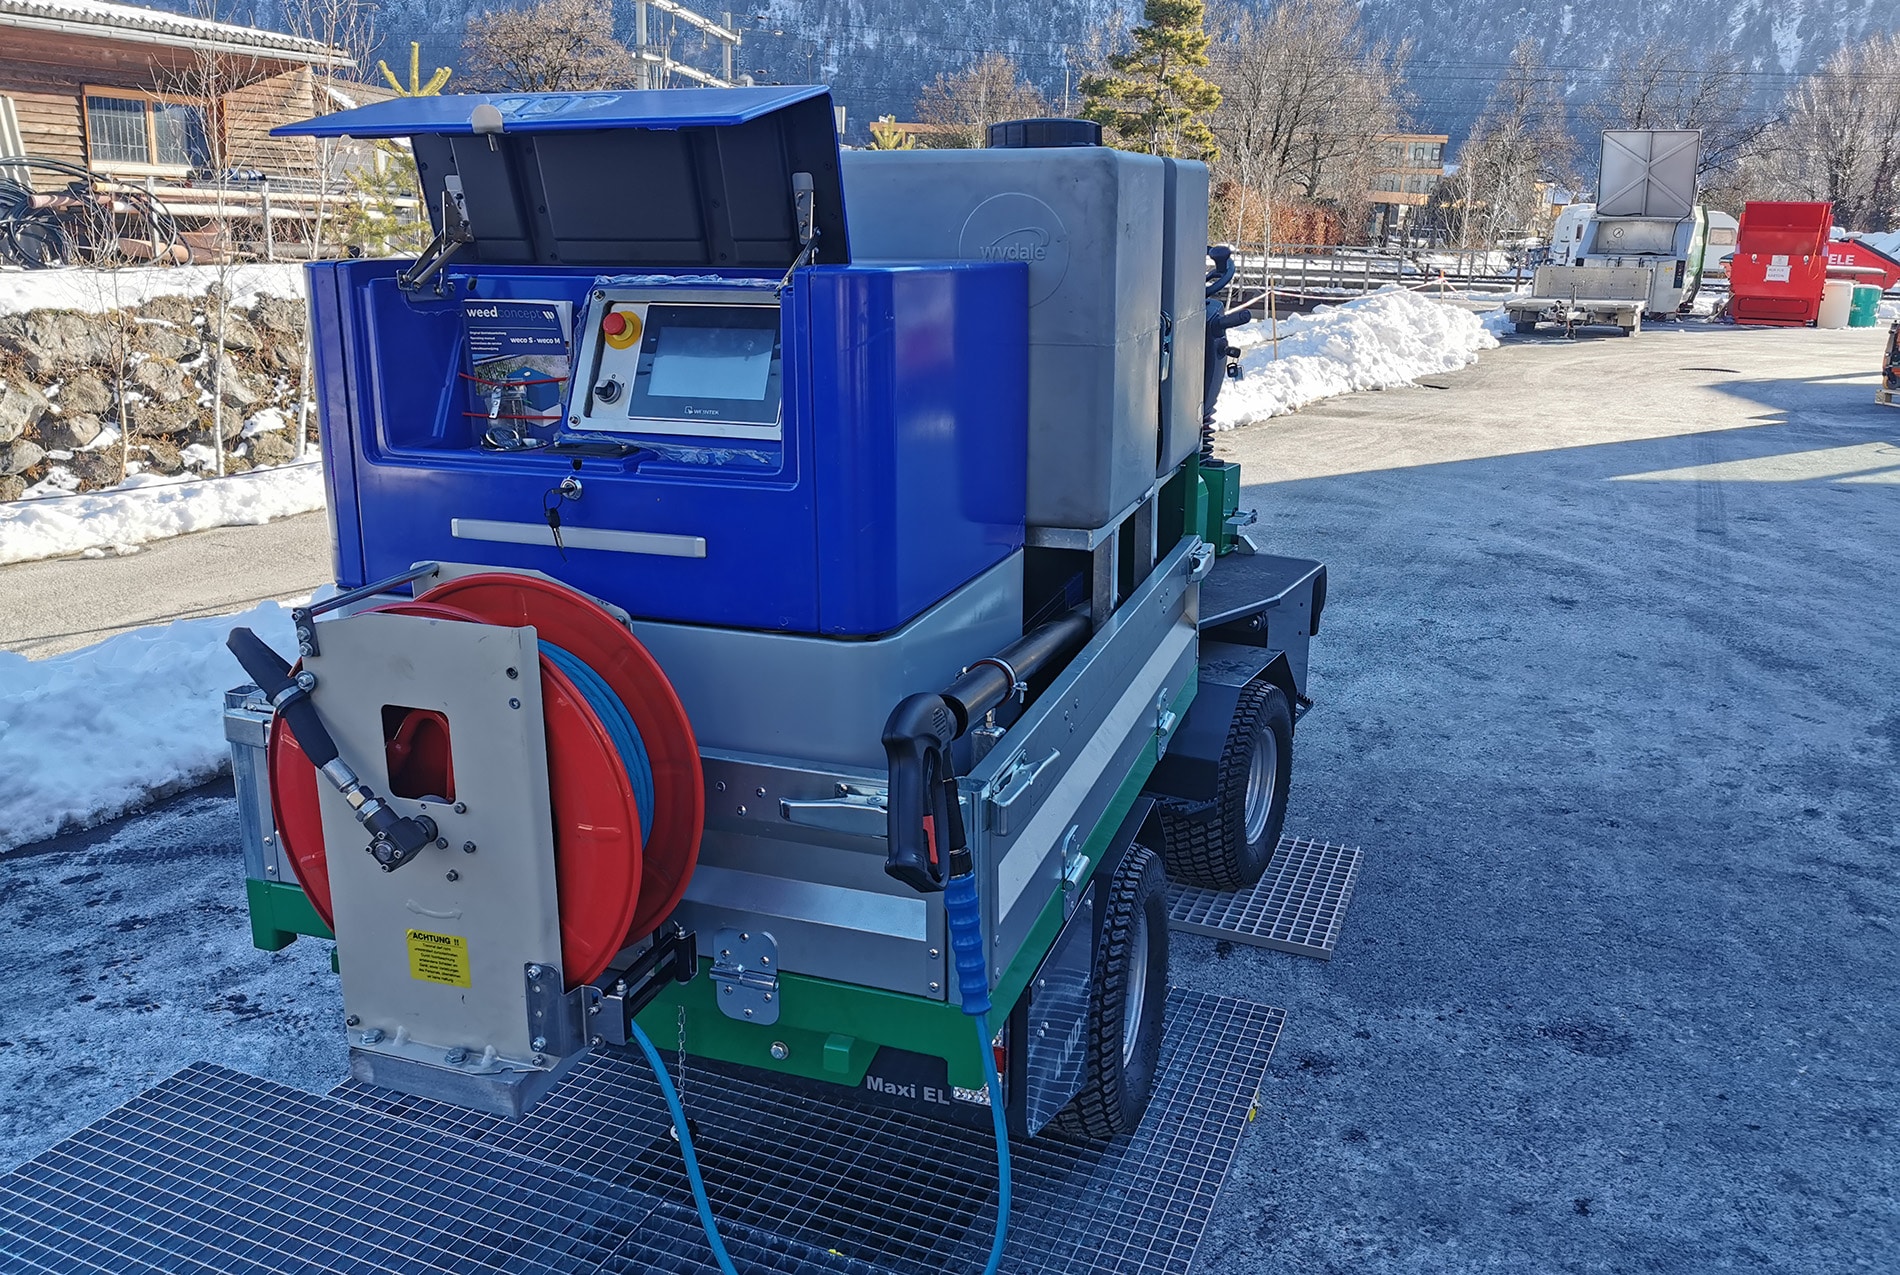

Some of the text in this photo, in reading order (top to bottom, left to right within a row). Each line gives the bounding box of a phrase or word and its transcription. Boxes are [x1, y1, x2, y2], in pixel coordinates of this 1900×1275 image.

[466, 305, 542, 321] weedconcept
[528, 336, 534, 344] S
[554, 337, 561, 345] M
[412, 932, 451, 944] ACHTUNG
[866, 1075, 950, 1106] Maxi EL
